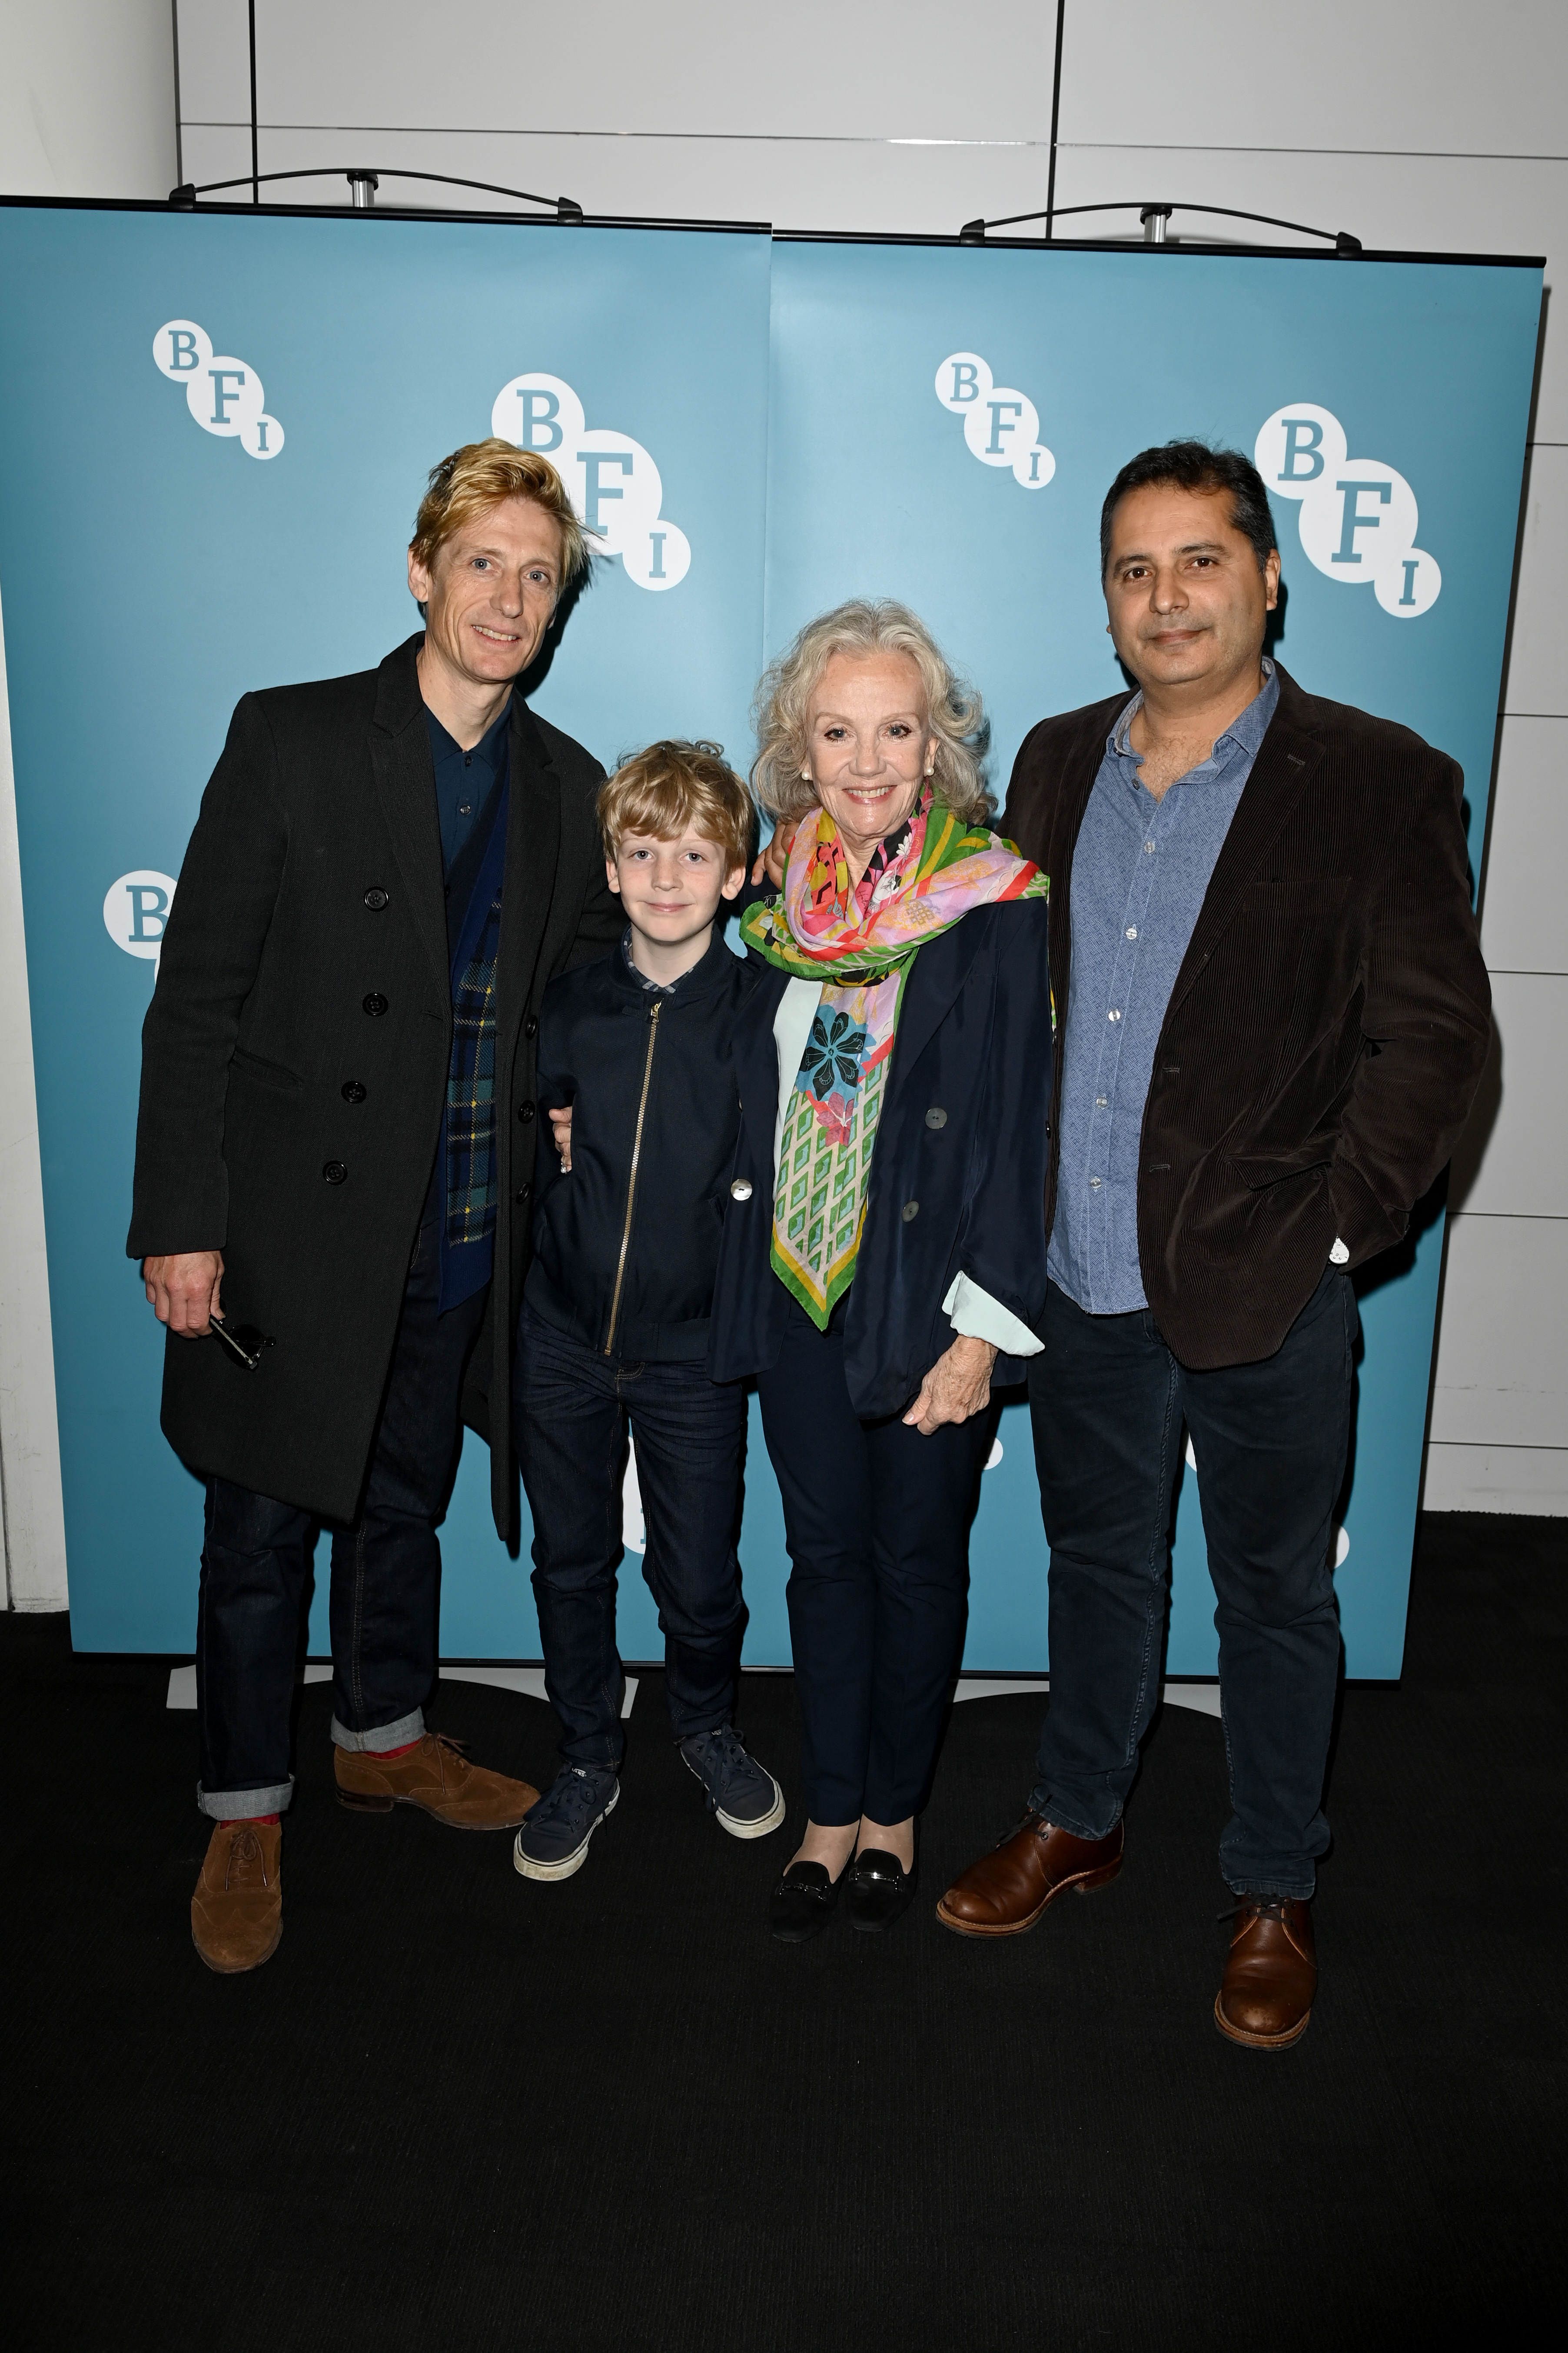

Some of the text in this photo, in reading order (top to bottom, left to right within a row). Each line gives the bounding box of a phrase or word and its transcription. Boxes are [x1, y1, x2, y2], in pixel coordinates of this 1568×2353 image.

[168, 330, 269, 451] BFI
[950, 363, 1040, 481] BFI
[517, 389, 667, 579] BFI
[1278, 419, 1419, 606] BFI
